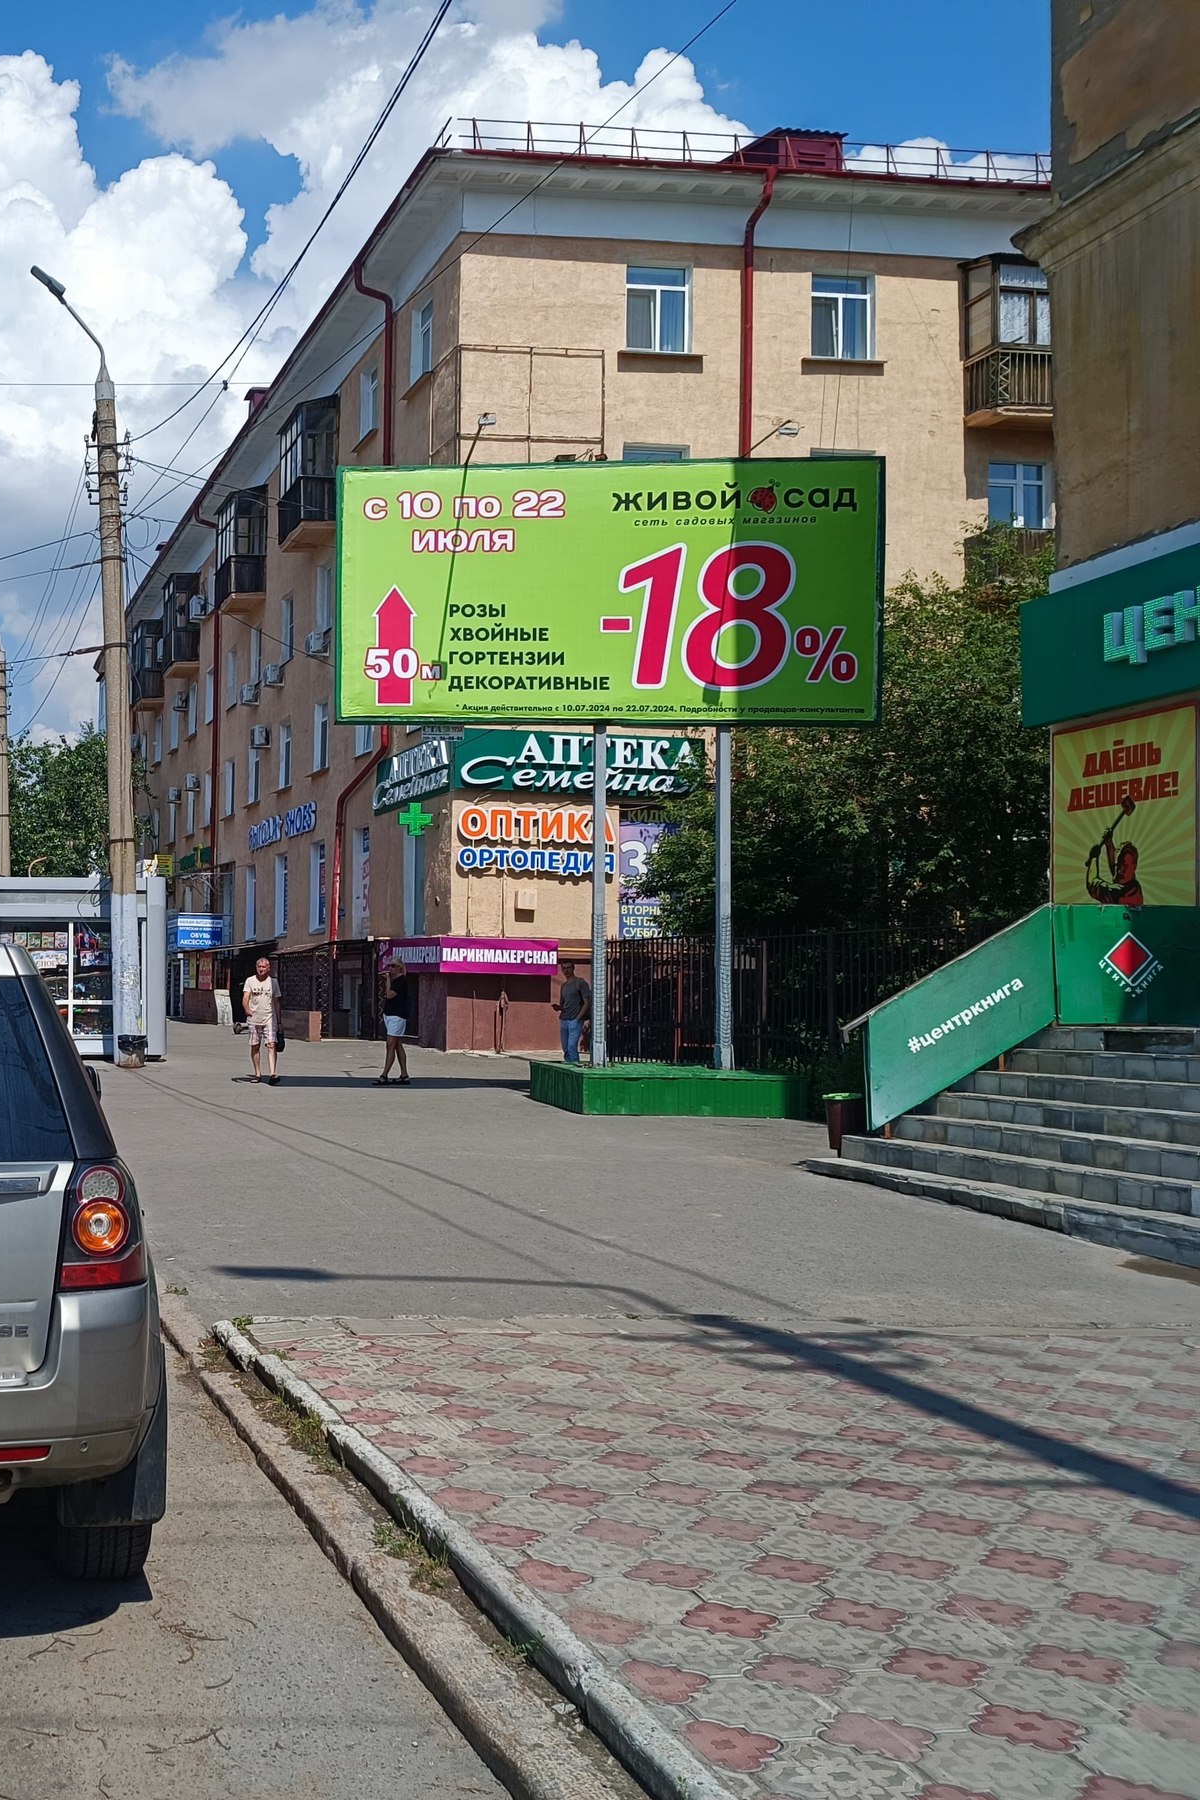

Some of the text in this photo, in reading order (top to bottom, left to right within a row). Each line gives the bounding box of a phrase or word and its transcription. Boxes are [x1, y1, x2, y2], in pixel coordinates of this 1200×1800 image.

[364, 490, 565, 518] с 10 по 22
[633, 515, 818, 527] сеть садовых магазинов
[449, 604, 506, 617] РОЗЫ
[450, 622, 549, 642] ХВОЙНЫЕ
[449, 651, 565, 666] ГОРТЕНЗИИ
[448, 676, 610, 692] ДЕКОРАТИВНЫЕ
[462, 704, 489, 712] Акция
[490, 704, 553, 712] действительна
[626, 705, 677, 713] 22.07.2024.
[679, 705, 737, 714] Подробности
[1082, 739, 1162, 778] ДАЁШЬ
[1067, 771, 1179, 812] ДЕШЕВЛЕ!
[285, 801, 316, 838] SHOES
[442, 947, 558, 965] ПАРИКМАХЕРСКАЯ
[907, 977, 1024, 1054] #центркнига
